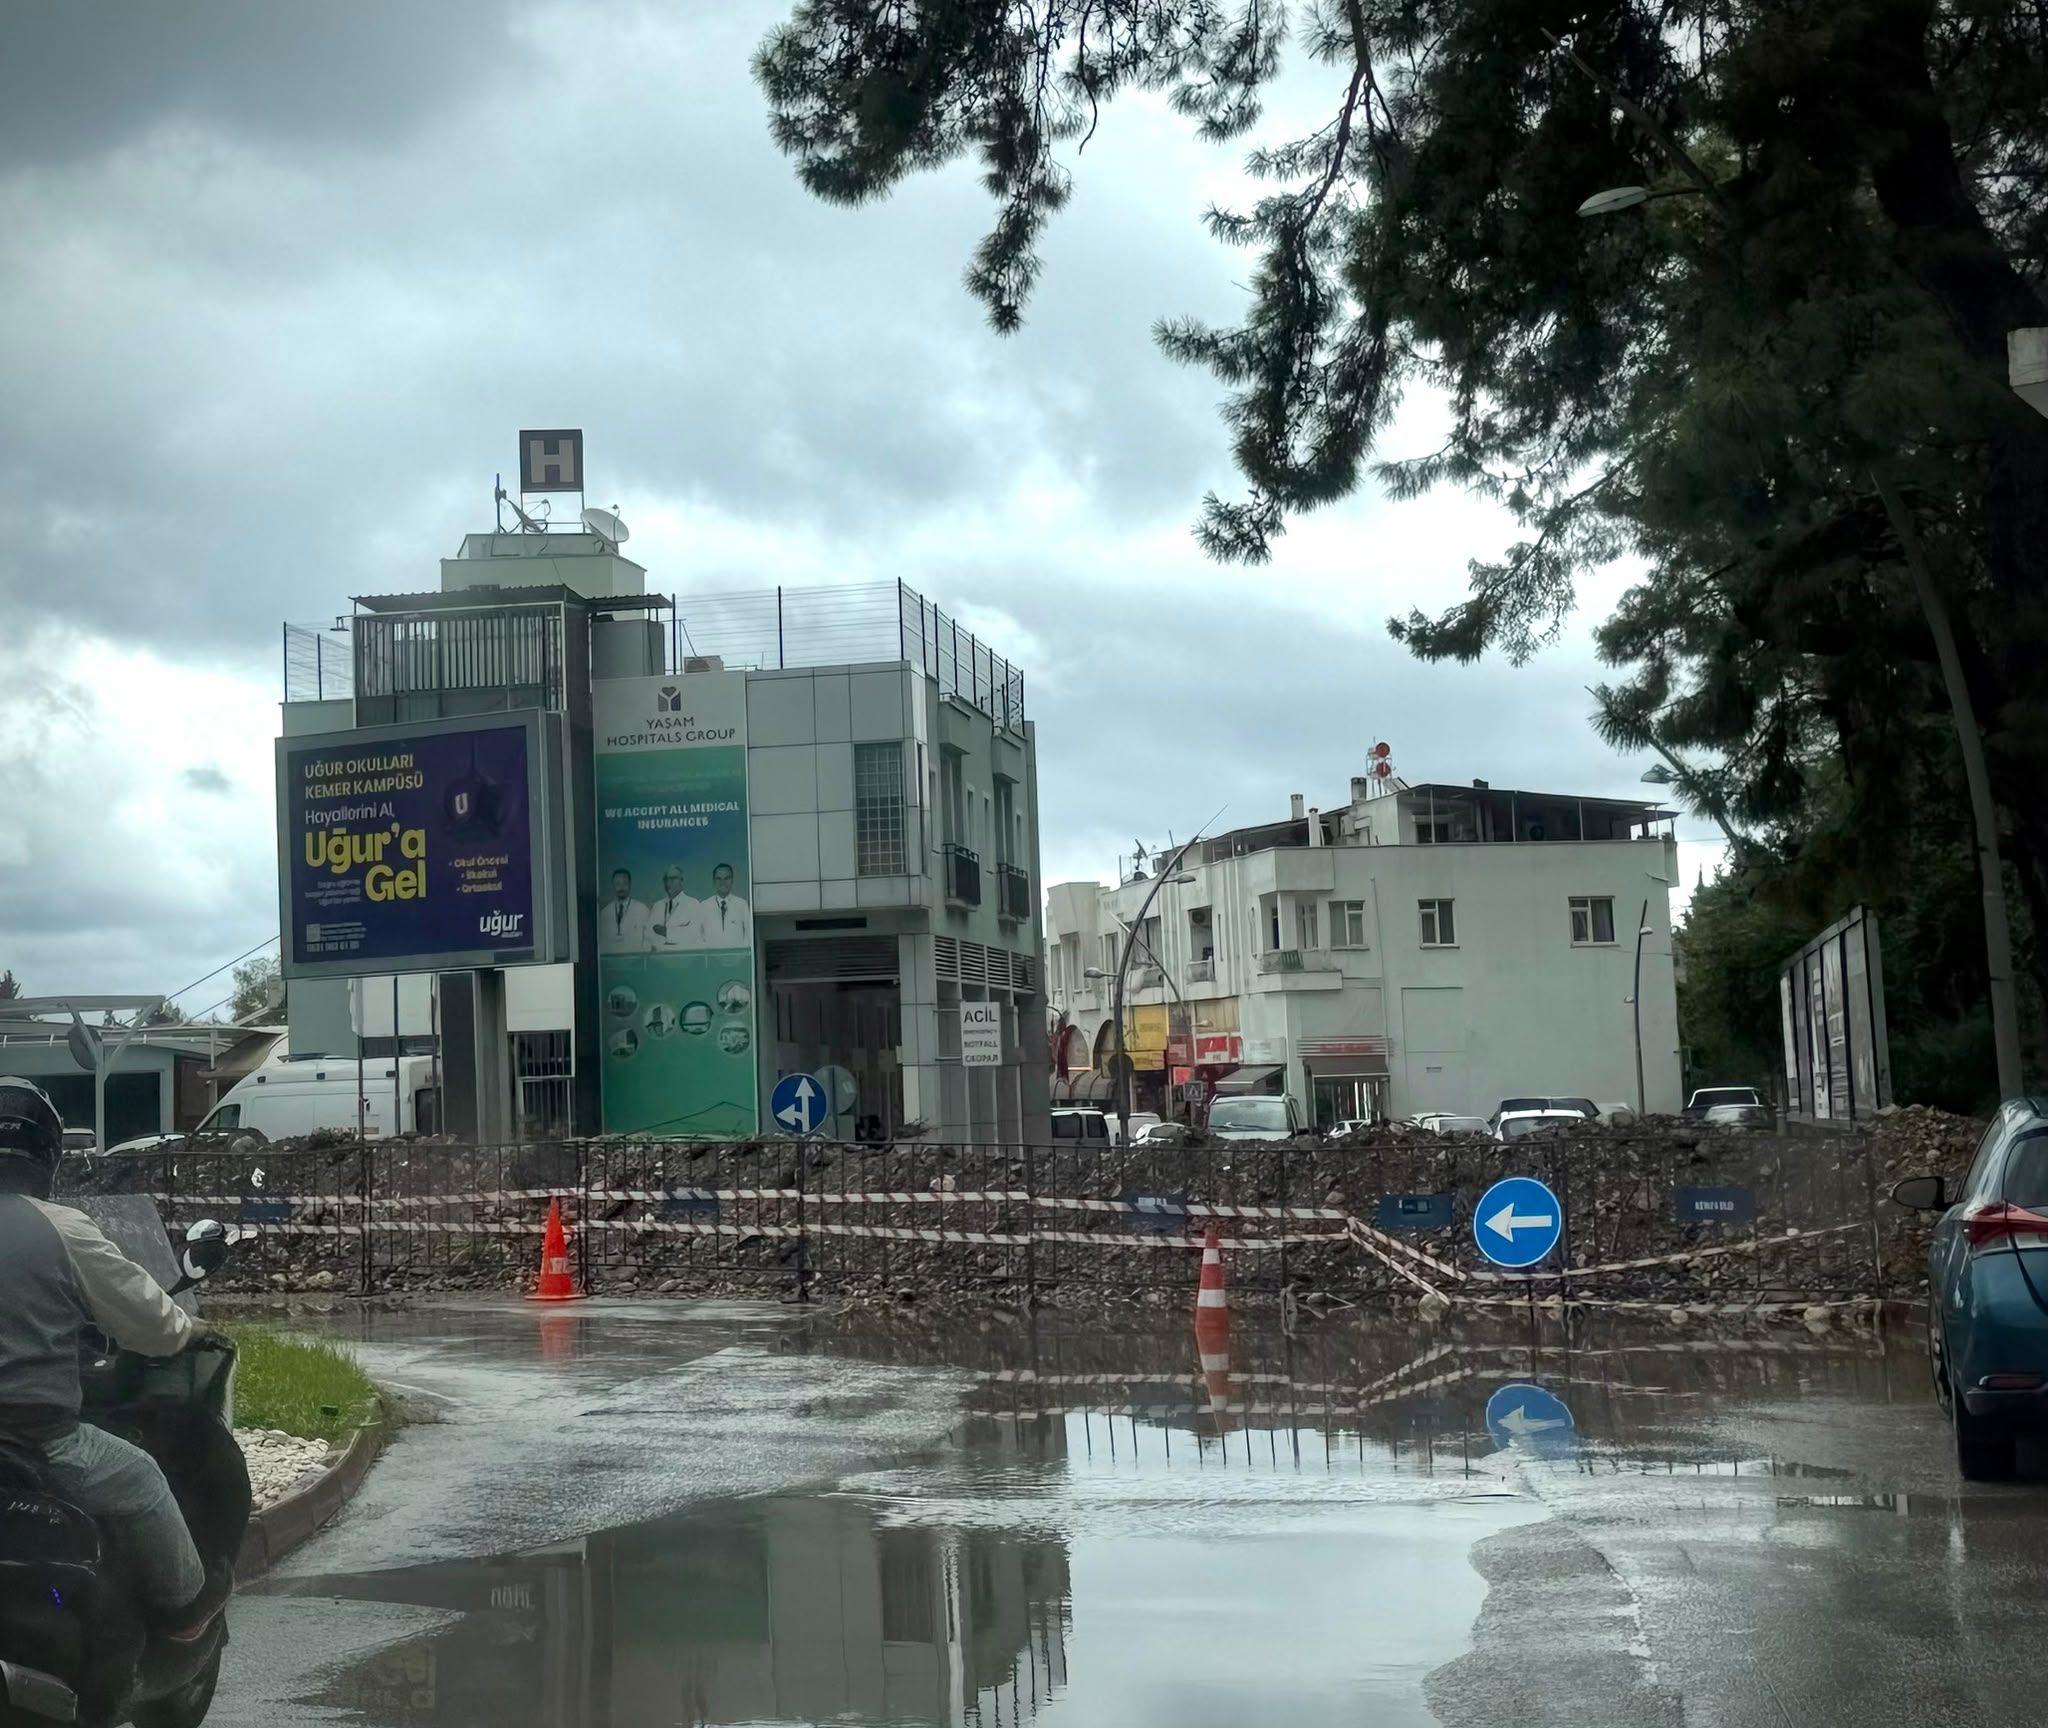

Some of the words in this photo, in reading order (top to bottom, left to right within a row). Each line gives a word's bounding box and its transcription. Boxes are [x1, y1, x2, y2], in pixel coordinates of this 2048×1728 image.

[530, 439, 574, 484] H
[607, 731, 682, 746] HOSPITALS
[686, 728, 735, 742] GROUP
[305, 760, 343, 779] UĞUR
[347, 753, 414, 774] OKULLARI
[305, 781, 352, 799] KEMER
[354, 771, 423, 795] KAMPÜSÜ
[604, 807, 622, 818] WE
[624, 805, 667, 817] ACCEPT
[669, 804, 688, 815] ALL
[690, 801, 740, 813] MEDICAL
[637, 816, 709, 830] INSURANCES
[305, 821, 426, 874] Uğur'a
[365, 859, 427, 902] Gel
[479, 909, 524, 937] uğur
